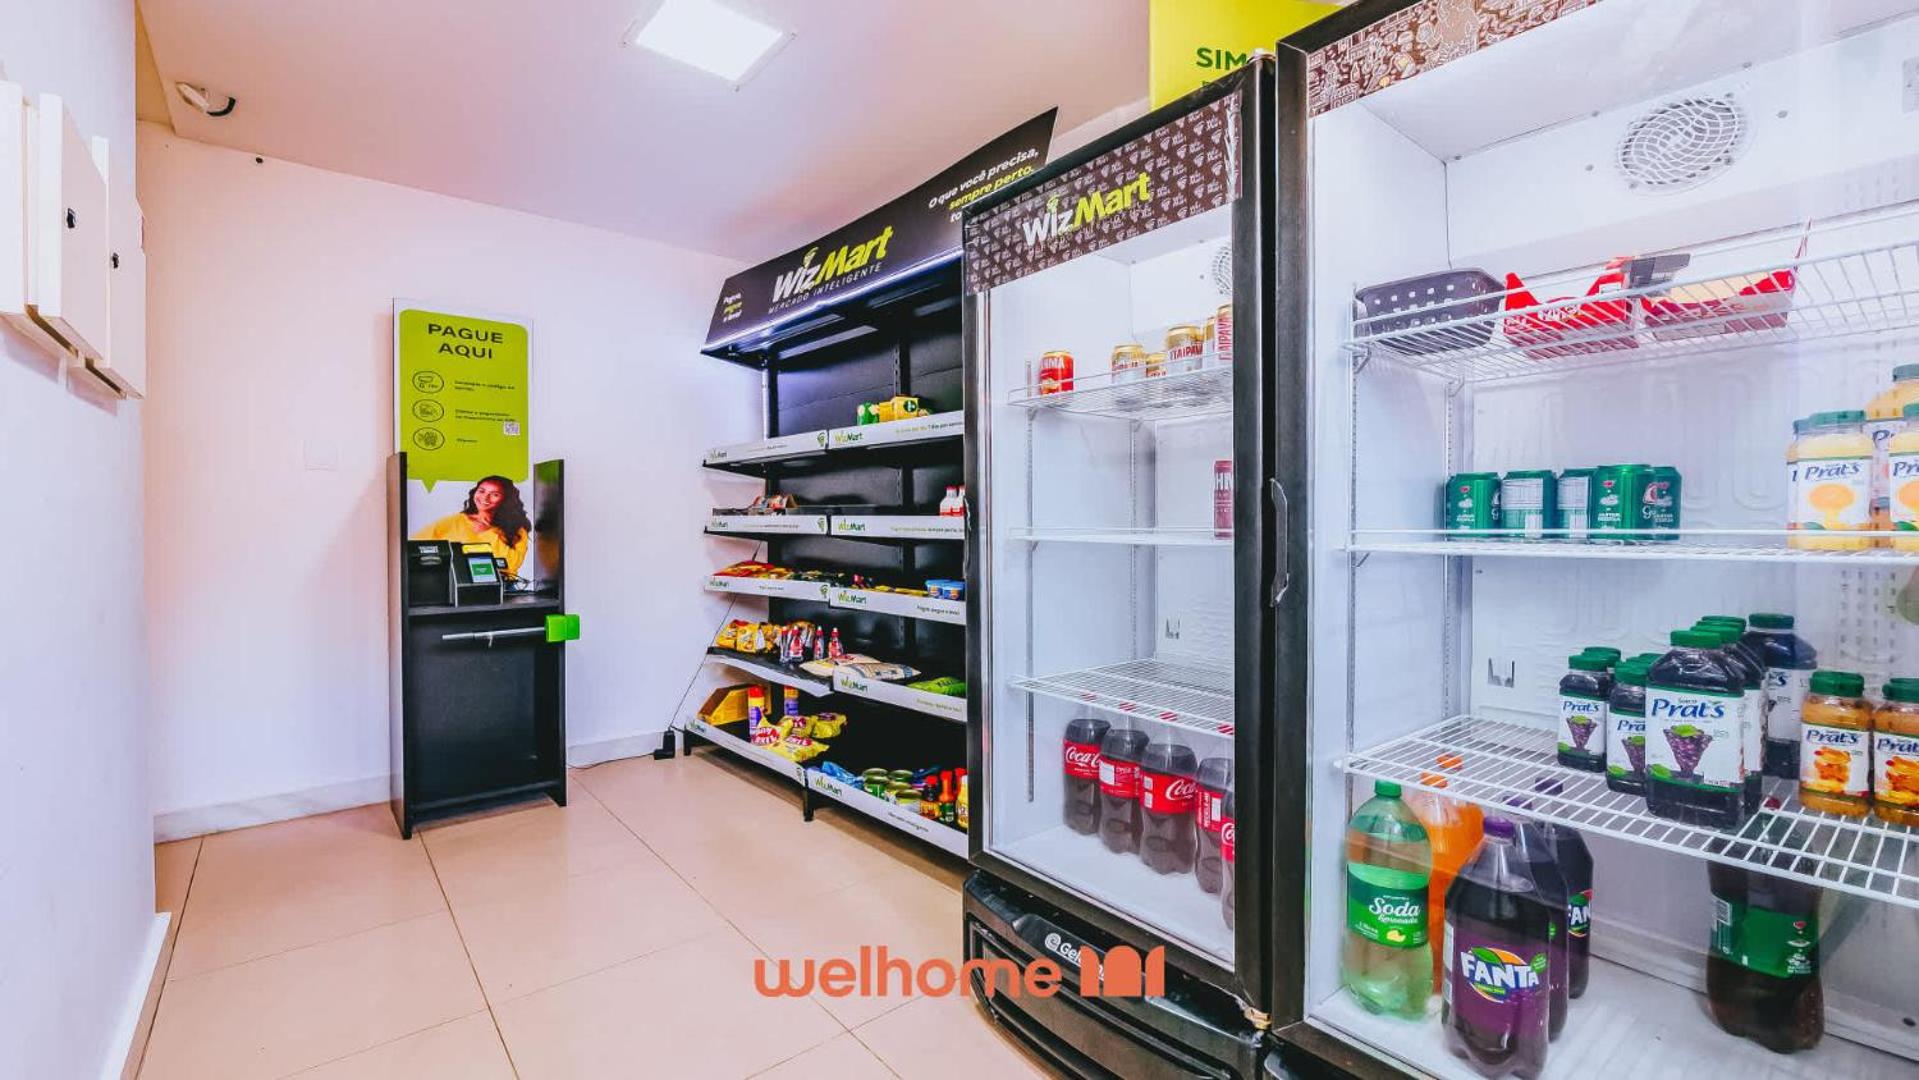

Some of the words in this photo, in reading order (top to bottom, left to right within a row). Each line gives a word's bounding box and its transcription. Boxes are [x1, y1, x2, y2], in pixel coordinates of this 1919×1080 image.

[928, 198, 938, 209] O
[938, 187, 959, 205] que
[960, 170, 986, 191] você
[986, 148, 1040, 180] precisa,
[949, 184, 993, 210] sempre
[1022, 172, 1150, 247] WizMart
[772, 225, 894, 303] WizMart
[768, 292, 809, 315] MERCADO
[813, 262, 882, 297] INTELIGENTE
[427, 323, 504, 344] PAGUE
[438, 342, 493, 359] AQUI
[1169, 342, 1203, 360] ITAIPAV
[1617, 719, 1645, 732] Pra
[1369, 897, 1420, 917] Soda
[1460, 952, 1539, 991] FANTA
